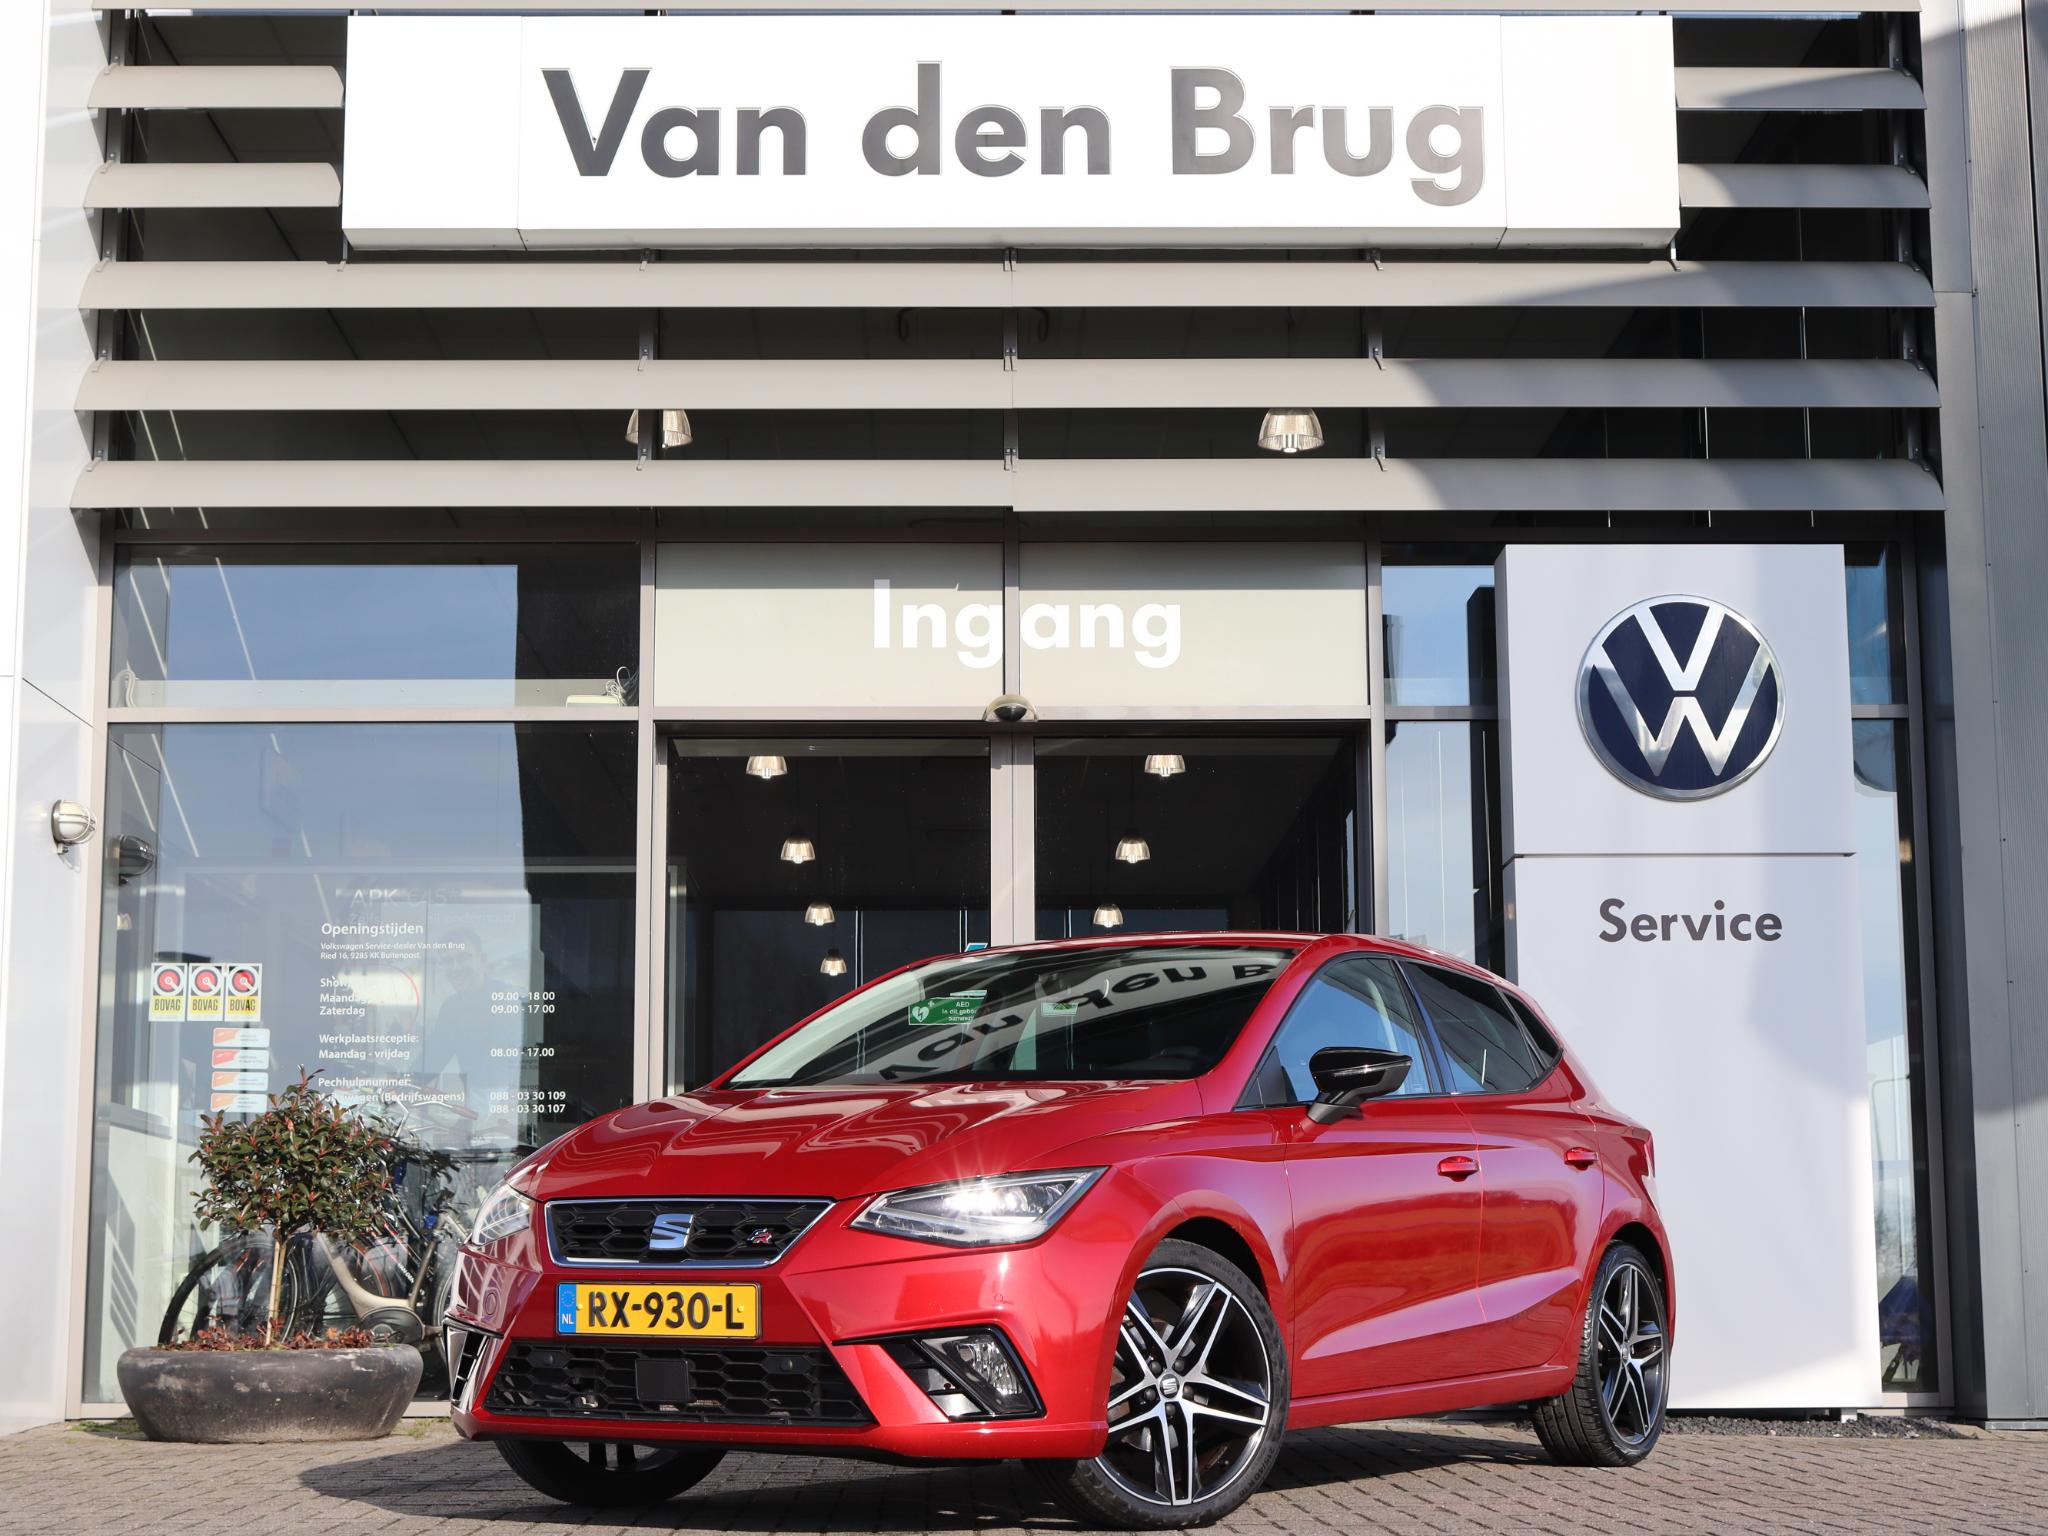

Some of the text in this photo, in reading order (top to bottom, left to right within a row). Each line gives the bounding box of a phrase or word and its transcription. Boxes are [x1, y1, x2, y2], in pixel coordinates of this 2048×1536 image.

[541, 60, 1486, 207] Van den Brug
[873, 579, 1181, 669] Ingang
[1599, 898, 1783, 943] Service
[321, 923, 424, 937] Openingstijden
[320, 942, 364, 951] Volkswagen
[417, 942, 431, 950] Van
[432, 942, 447, 950] den
[320, 952, 337, 960] Ried
[491, 992, 519, 1001] 09.00
[154, 999, 181, 1011] BOVAG
[192, 999, 218, 1011] BOVAG
[230, 999, 256, 1011] BOVAG
[320, 1006, 365, 1017] Zaterdag
[491, 1005, 519, 1014] 09.00
[319, 1033, 419, 1046] Werkplaatsreceptie:
[319, 1049, 366, 1061] Maandag
[374, 1049, 410, 1061] vrijdag
[490, 1048, 518, 1057] 08.00
[527, 1048, 555, 1057] 17.00
[381, 1091, 465, 1103] (Bedrijfswagens)
[489, 1091, 509, 1100] 088
[517, 1091, 529, 1100] 03
[532, 1091, 545, 1100] 30
[547, 1091, 566, 1100] 109
[489, 1104, 509, 1114] 088
[517, 1104, 529, 1113] 03
[532, 1104, 545, 1113] 30
[547, 1104, 566, 1113] 107
[588, 1291, 745, 1330] RX-930-L
[561, 1313, 574, 1325] NL
